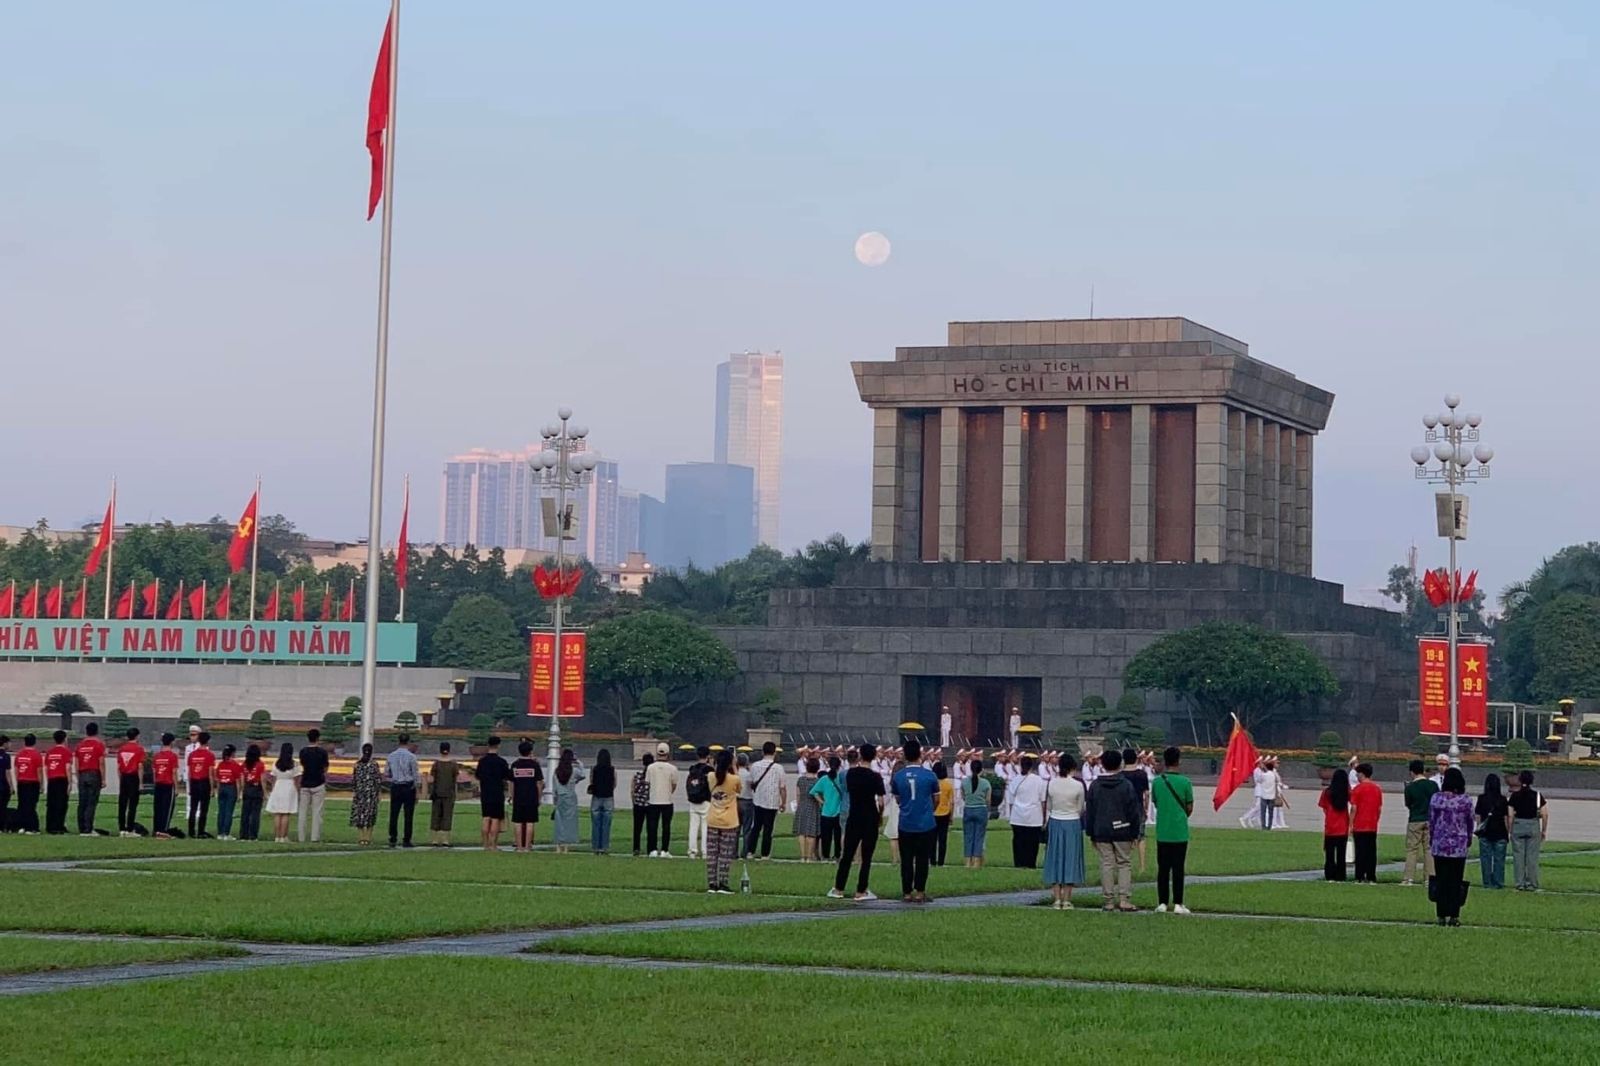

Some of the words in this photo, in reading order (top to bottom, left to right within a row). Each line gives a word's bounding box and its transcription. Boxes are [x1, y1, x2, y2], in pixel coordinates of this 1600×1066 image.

[53, 622, 110, 655] VIỆT
[122, 627, 183, 652] NAM
[195, 624, 276, 653] MUÔN
[288, 625, 351, 655] NĂM
[1462, 677, 1482, 691] 19-8
[908, 778, 916, 801] 1
